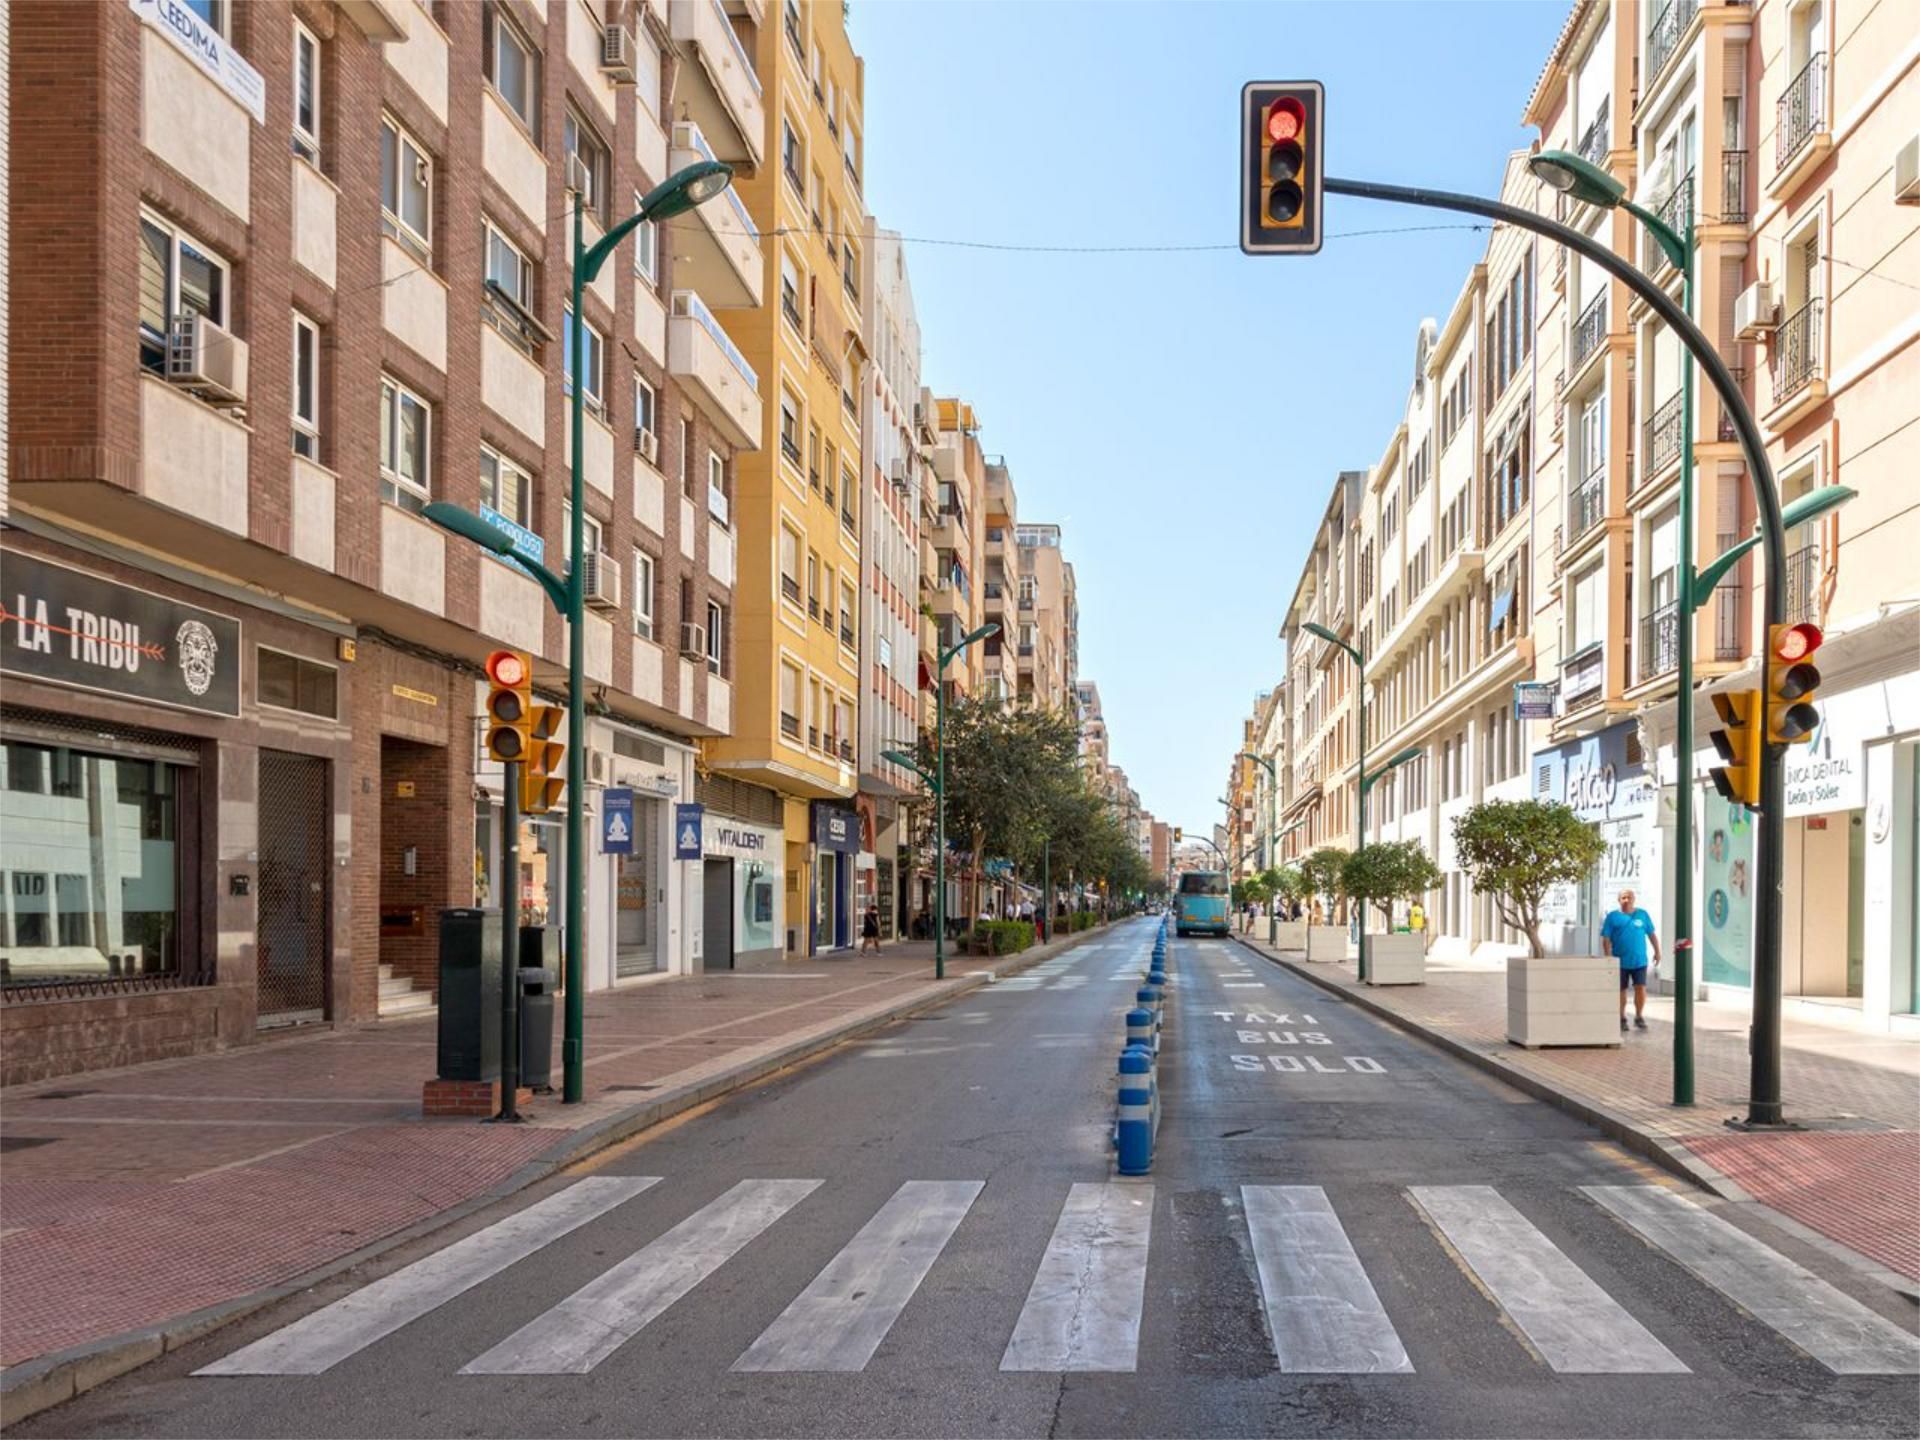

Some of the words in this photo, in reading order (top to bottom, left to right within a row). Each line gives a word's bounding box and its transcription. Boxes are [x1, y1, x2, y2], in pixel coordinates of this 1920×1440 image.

[157, 0, 219, 64] CEEDIMA
[17, 594, 51, 653] LA
[66, 607, 139, 672] TRIBU
[1813, 758, 1852, 781] DENTAL
[718, 828, 766, 850] VITALDENT
[1213, 1011, 1319, 1025] TAXI
[1236, 1029, 1334, 1045] BUS
[1230, 1055, 1388, 1074] SOLO
